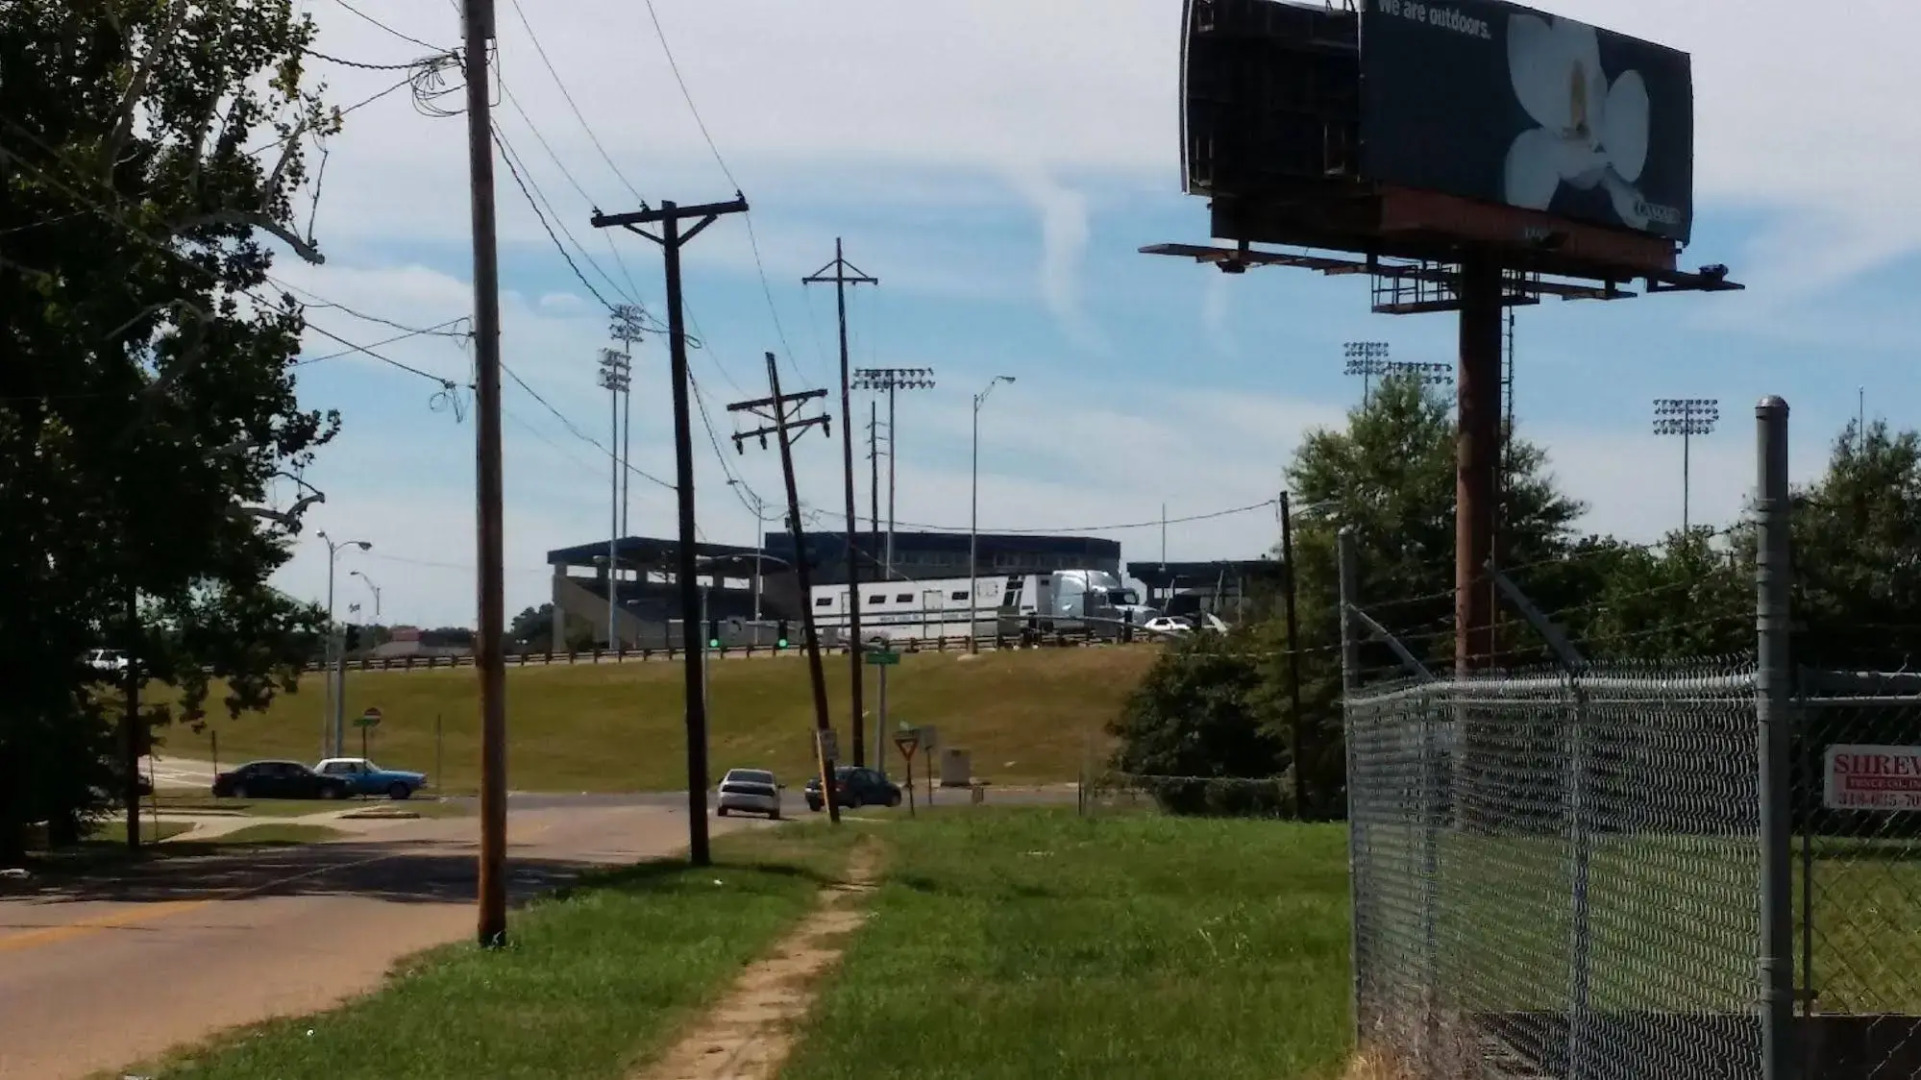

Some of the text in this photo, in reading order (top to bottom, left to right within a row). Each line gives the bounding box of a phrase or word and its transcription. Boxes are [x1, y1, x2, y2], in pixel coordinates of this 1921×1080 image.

[1378, 0, 1492, 39] We are outdoors.
